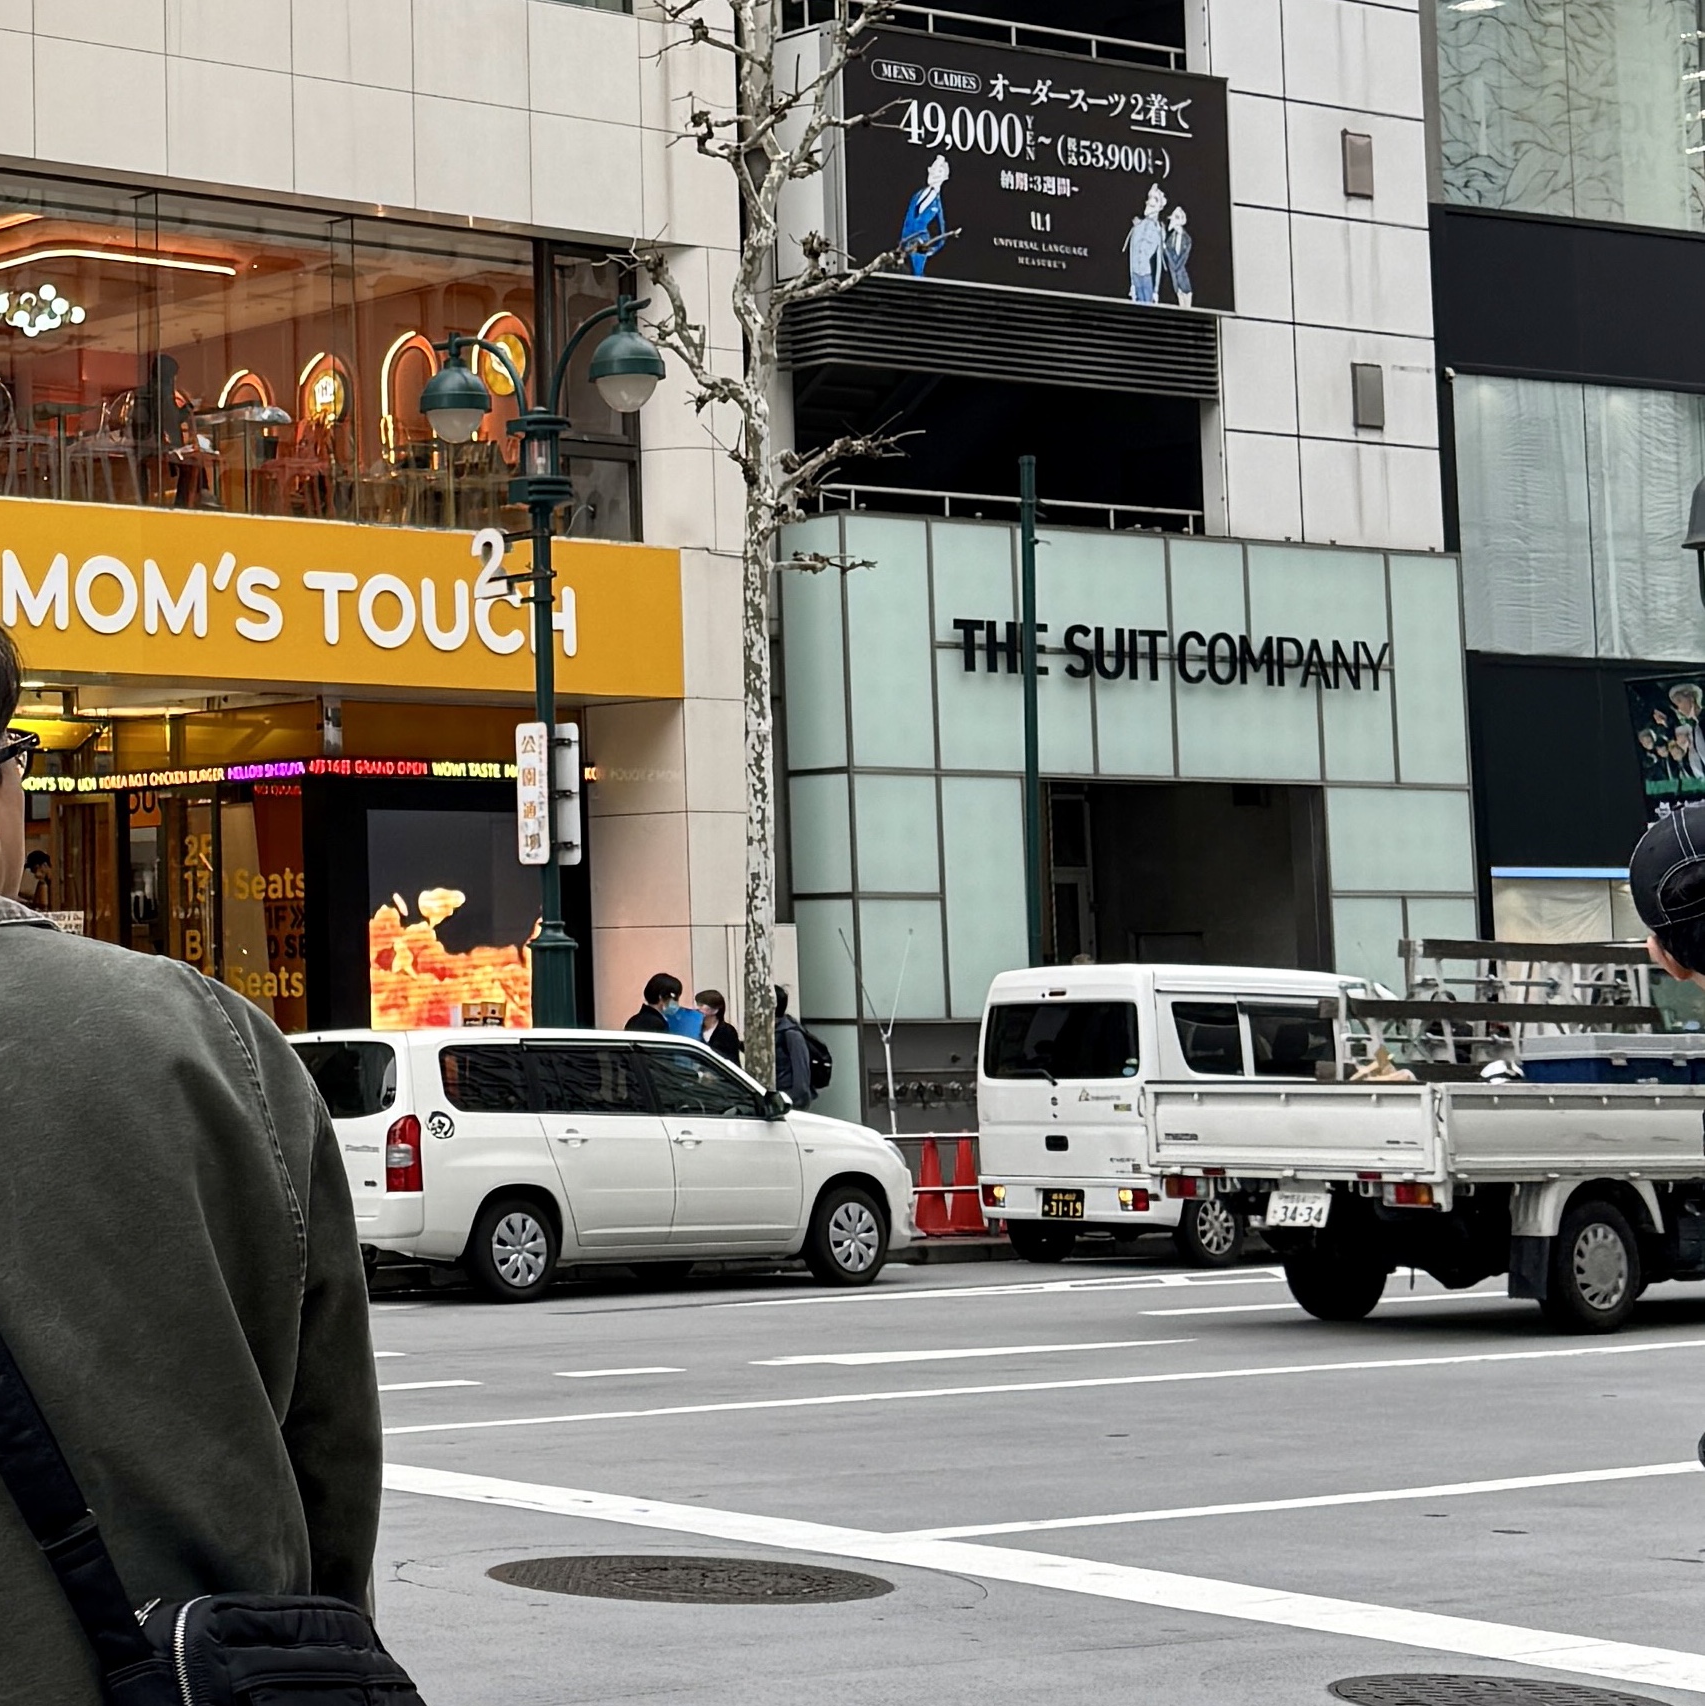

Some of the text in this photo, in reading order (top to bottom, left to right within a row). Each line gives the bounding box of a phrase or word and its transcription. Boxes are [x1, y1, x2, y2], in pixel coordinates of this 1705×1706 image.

[881, 62, 977, 91] MENS LADIES
[1, 549, 284, 642] MOM'S
[1063, 624, 1167, 681] SUIT
[1177, 631, 1390, 691] COMPANY
[397, 761, 428, 775] OPEN
[468, 763, 501, 778] TASTE
[236, 867, 305, 900] Seats
